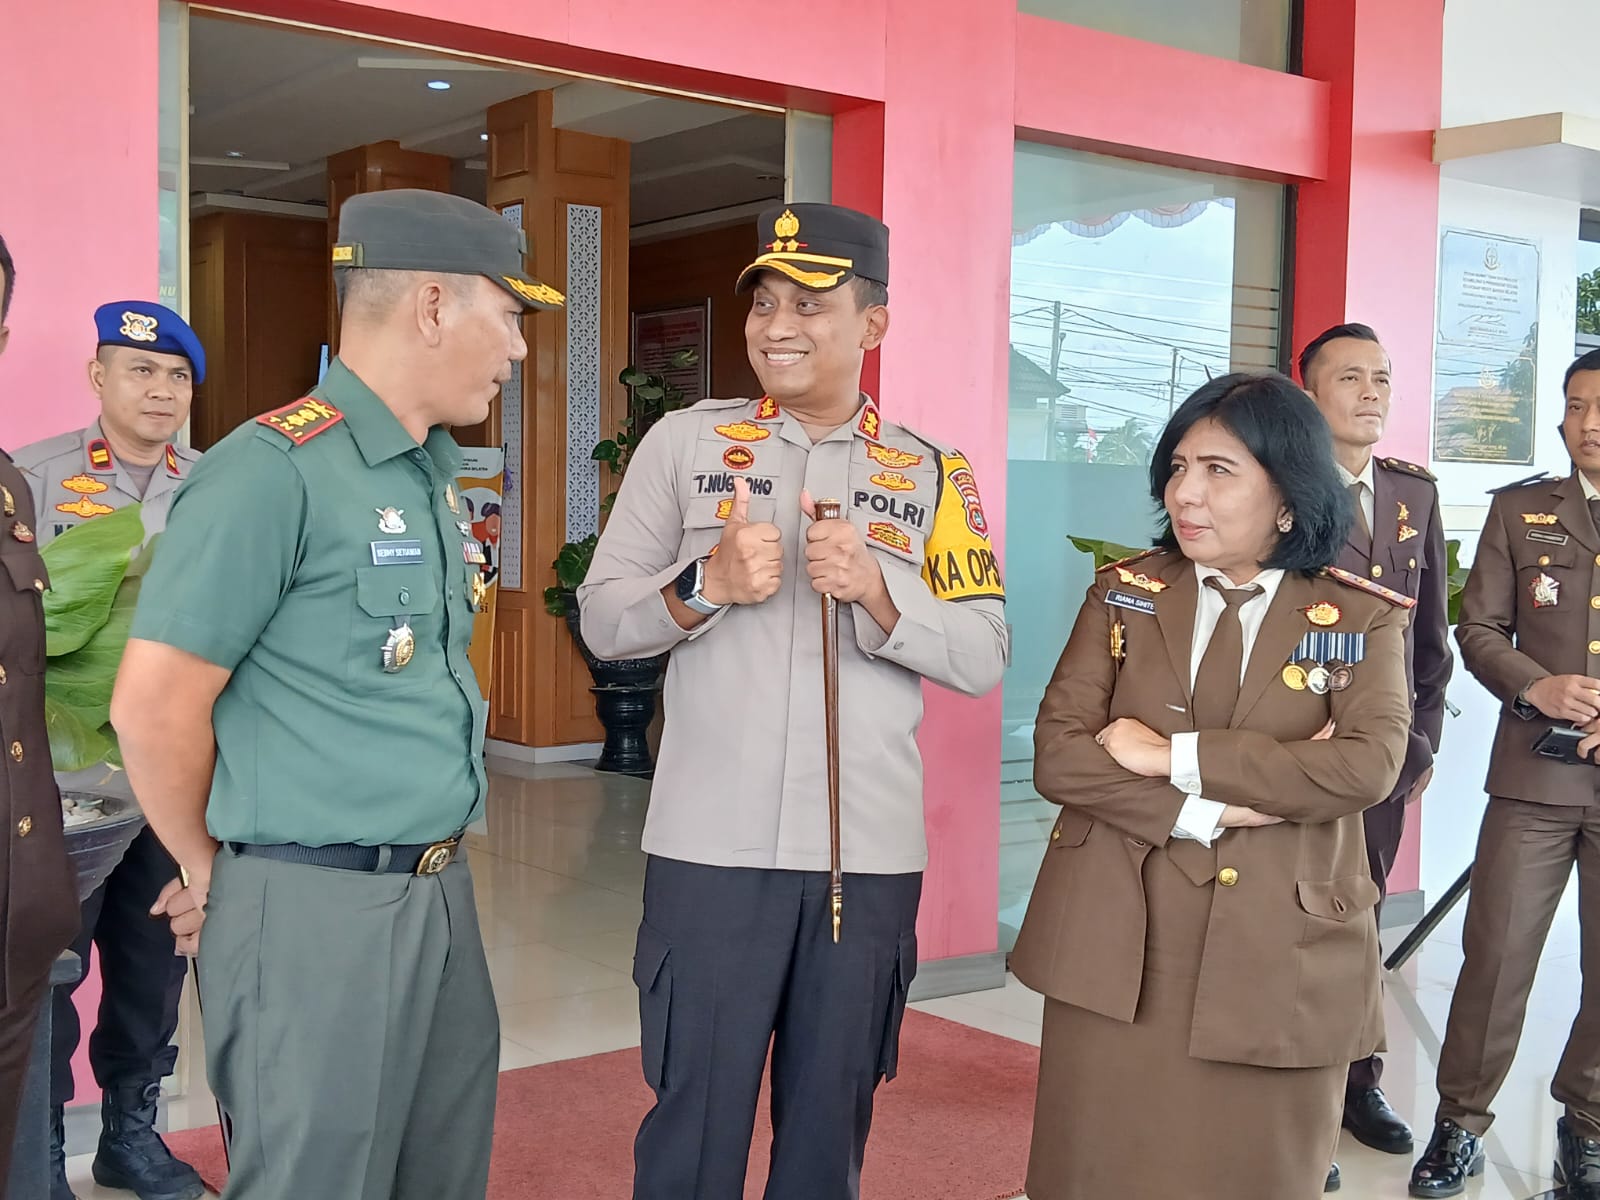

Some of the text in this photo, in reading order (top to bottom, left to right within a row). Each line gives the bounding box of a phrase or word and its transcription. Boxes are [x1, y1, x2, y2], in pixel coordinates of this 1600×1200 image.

[693, 473, 772, 495] T.NUGOHO
[854, 491, 925, 528] POLRI
[927, 549, 1001, 595] KA OPS
